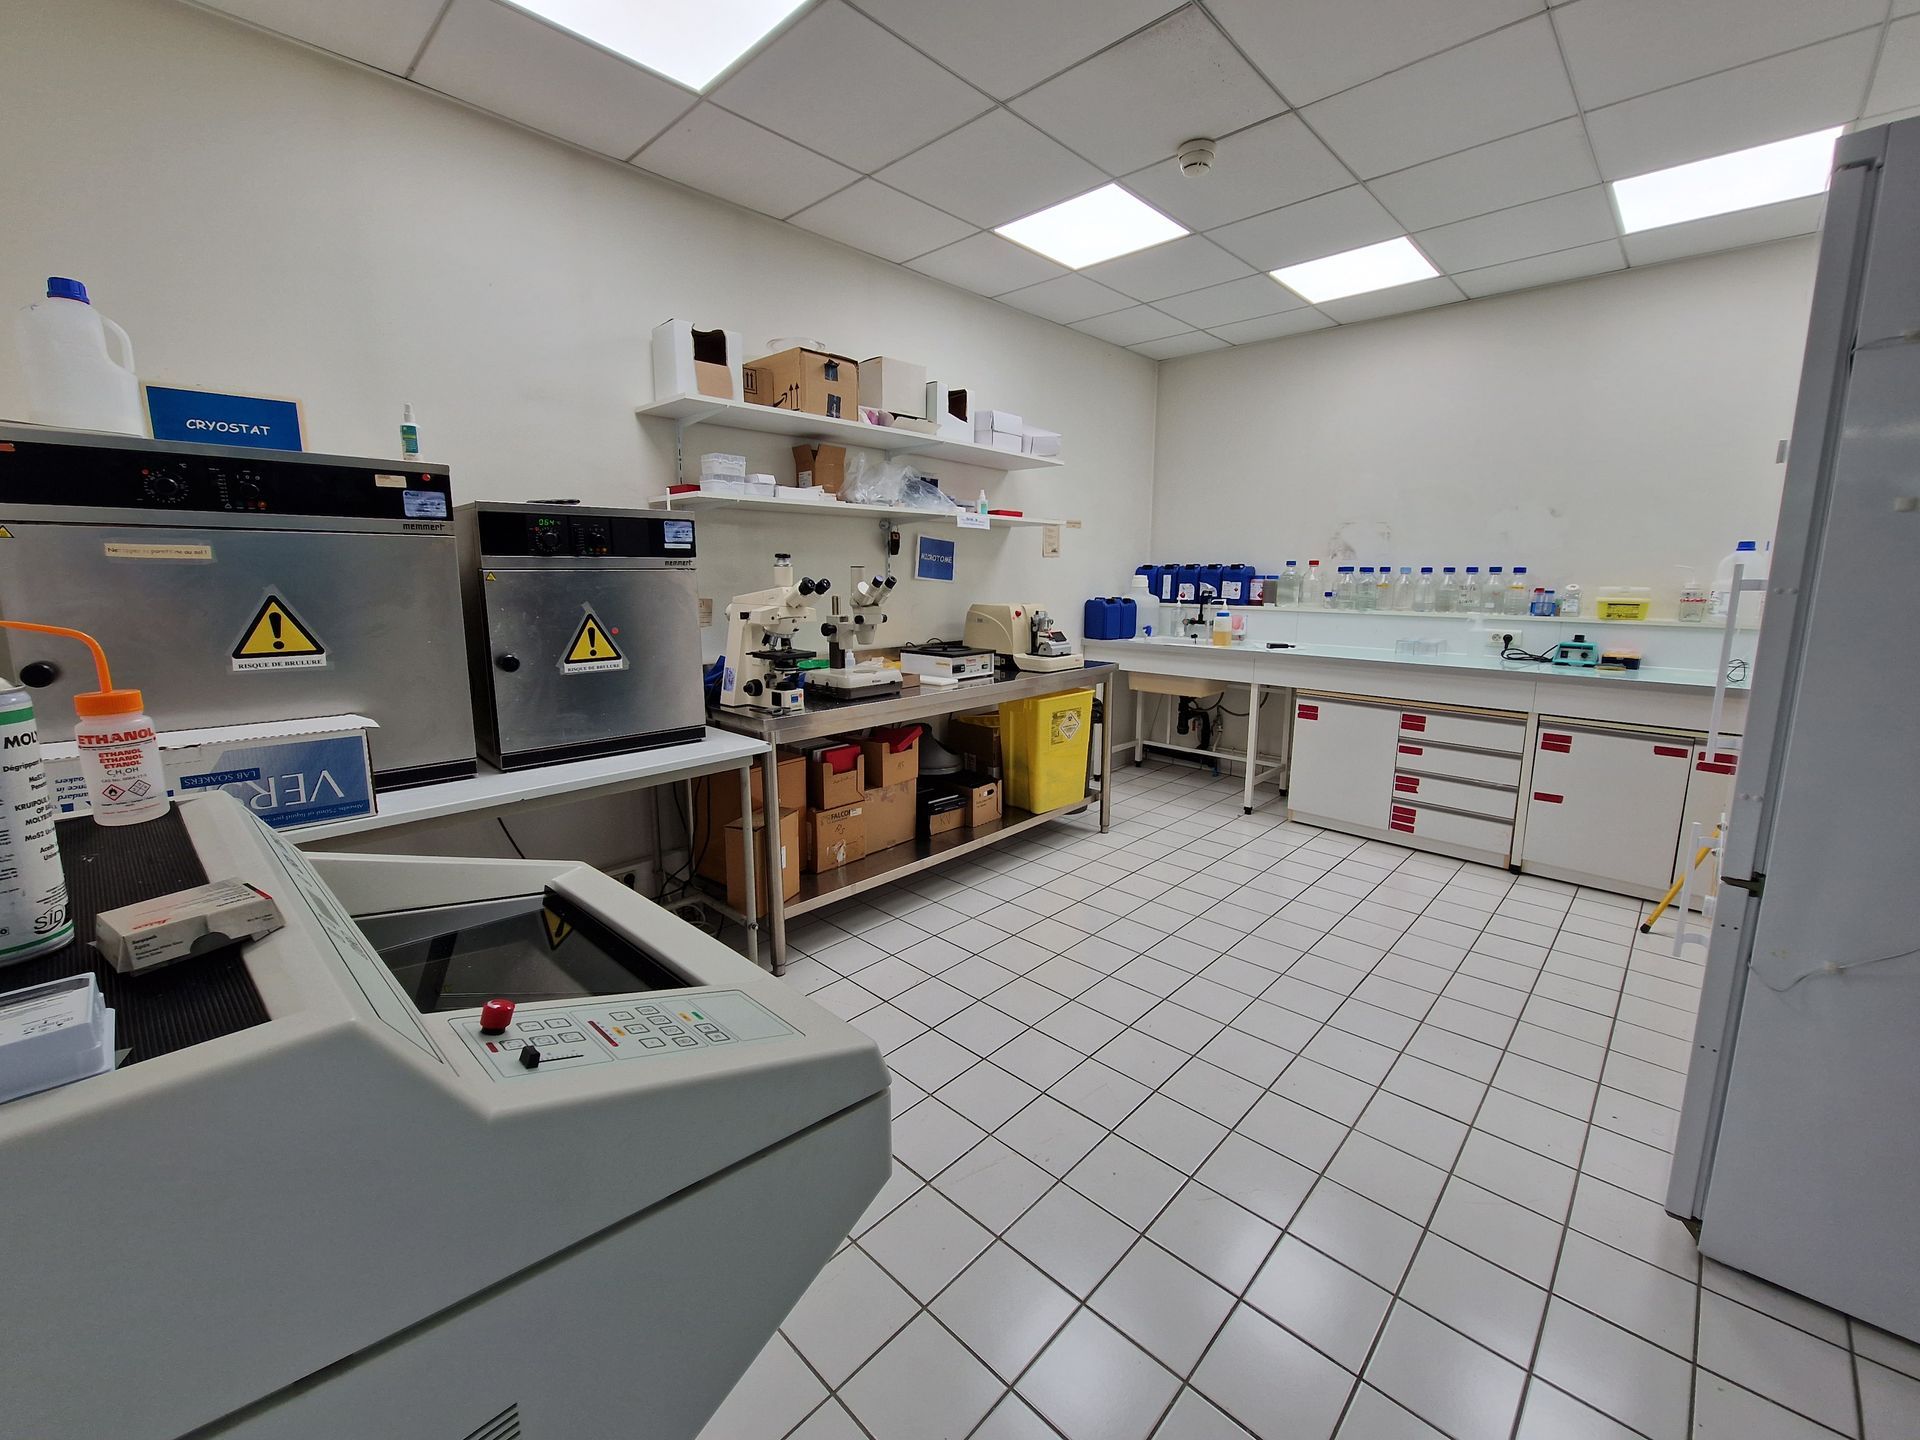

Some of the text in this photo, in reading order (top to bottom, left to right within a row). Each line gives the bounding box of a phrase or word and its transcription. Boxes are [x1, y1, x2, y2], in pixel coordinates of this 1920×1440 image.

[186, 419, 271, 436] CRYOSTAT
[402, 523, 445, 531] memmert
[77, 728, 154, 745] ETHANOL
[98, 748, 143, 758] ETHANOL
[99, 754, 144, 764] ETHANOL
[104, 760, 142, 769] ETANOL
[54, 776, 84, 785] oakers
[184, 769, 256, 787] LAB SOAKERS
[57, 792, 89, 802] andard
